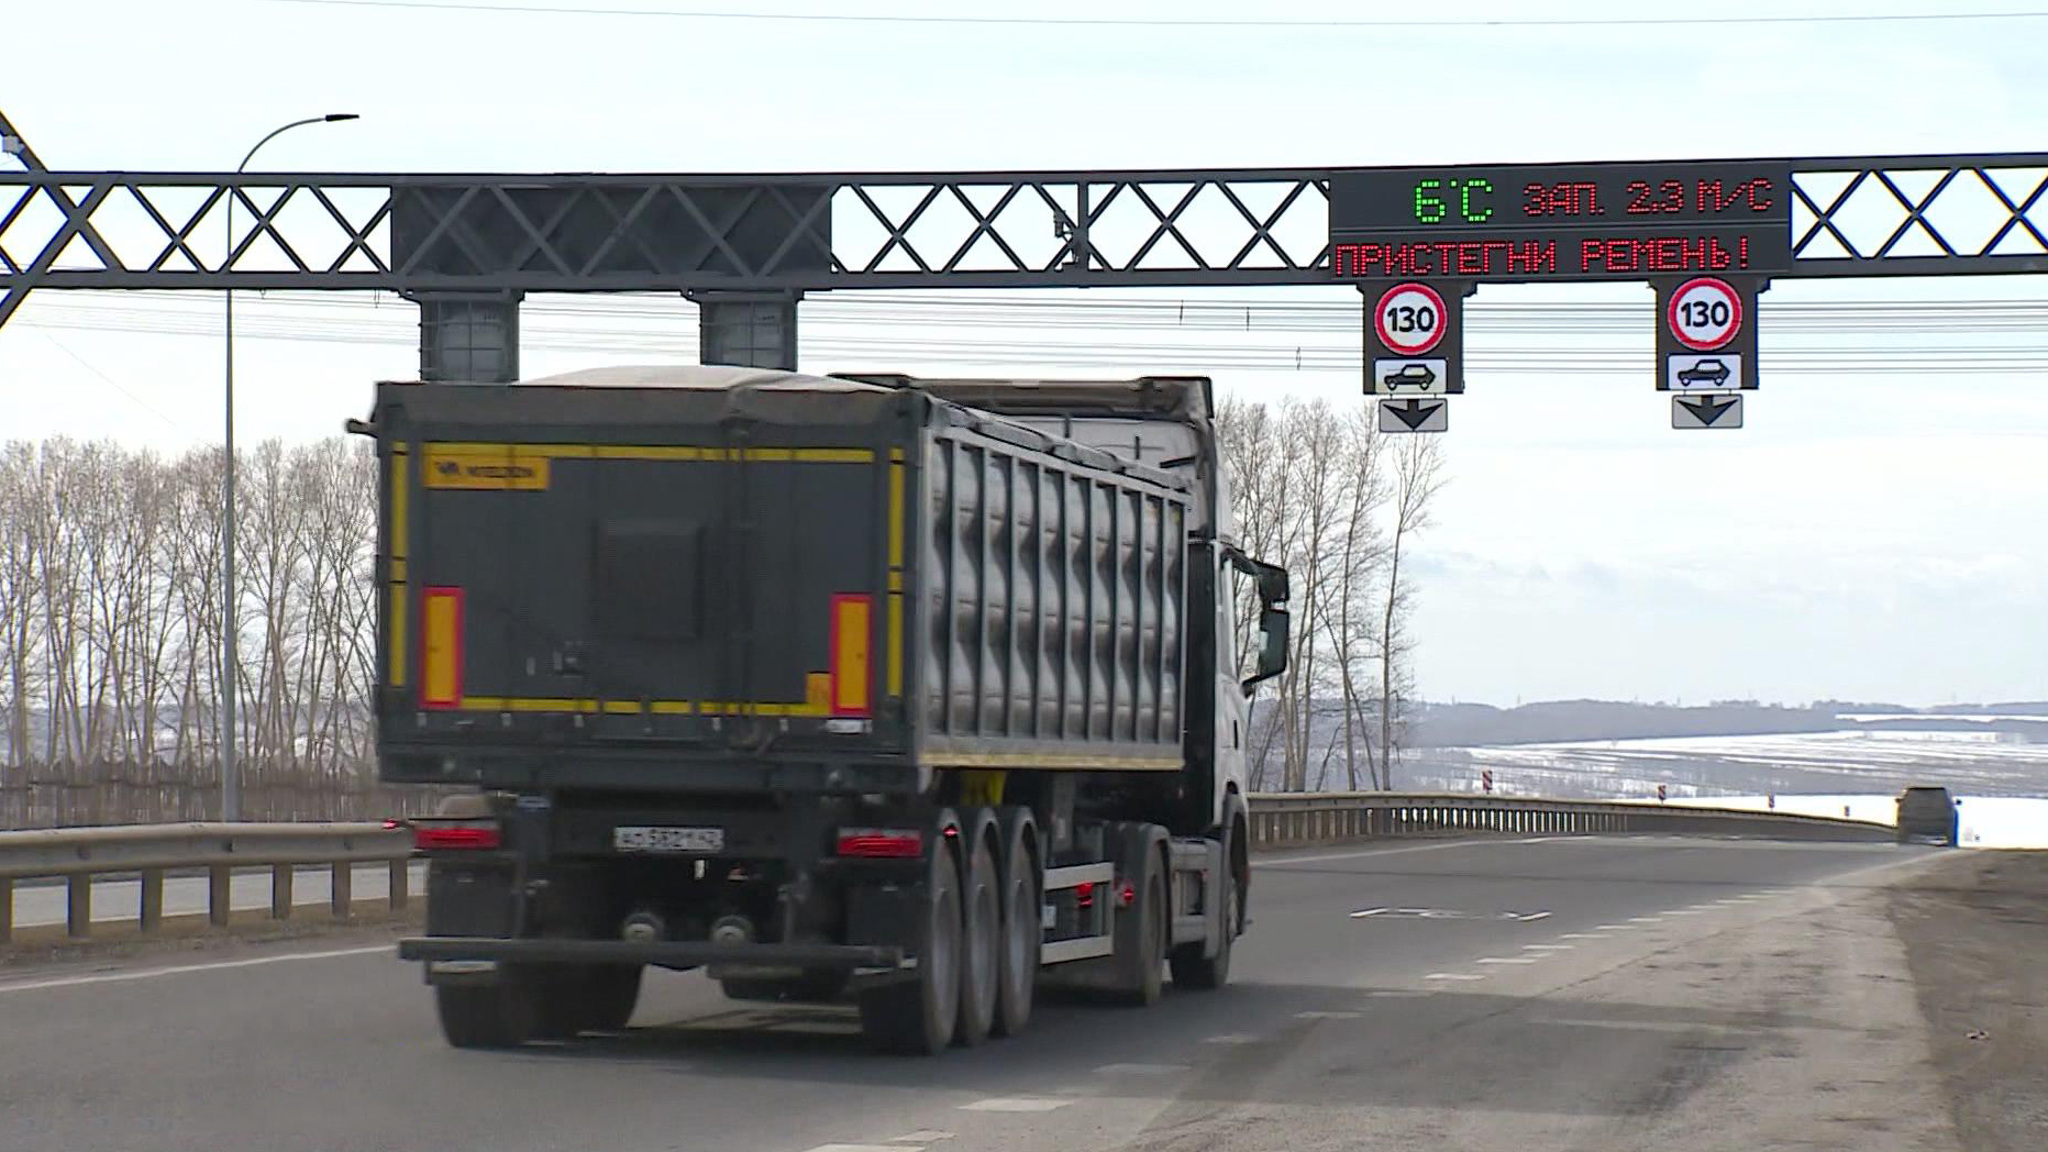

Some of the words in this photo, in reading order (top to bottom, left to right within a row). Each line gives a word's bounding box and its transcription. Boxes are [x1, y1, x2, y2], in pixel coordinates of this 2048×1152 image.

[1523, 182, 1605, 216] ЗАП.
[1335, 240, 1556, 277] ПРИСТЕГНИ
[1581, 236, 1749, 272] РЕМЕНЬ!
[1387, 306, 1435, 333] 130
[1681, 301, 1729, 327] 130
